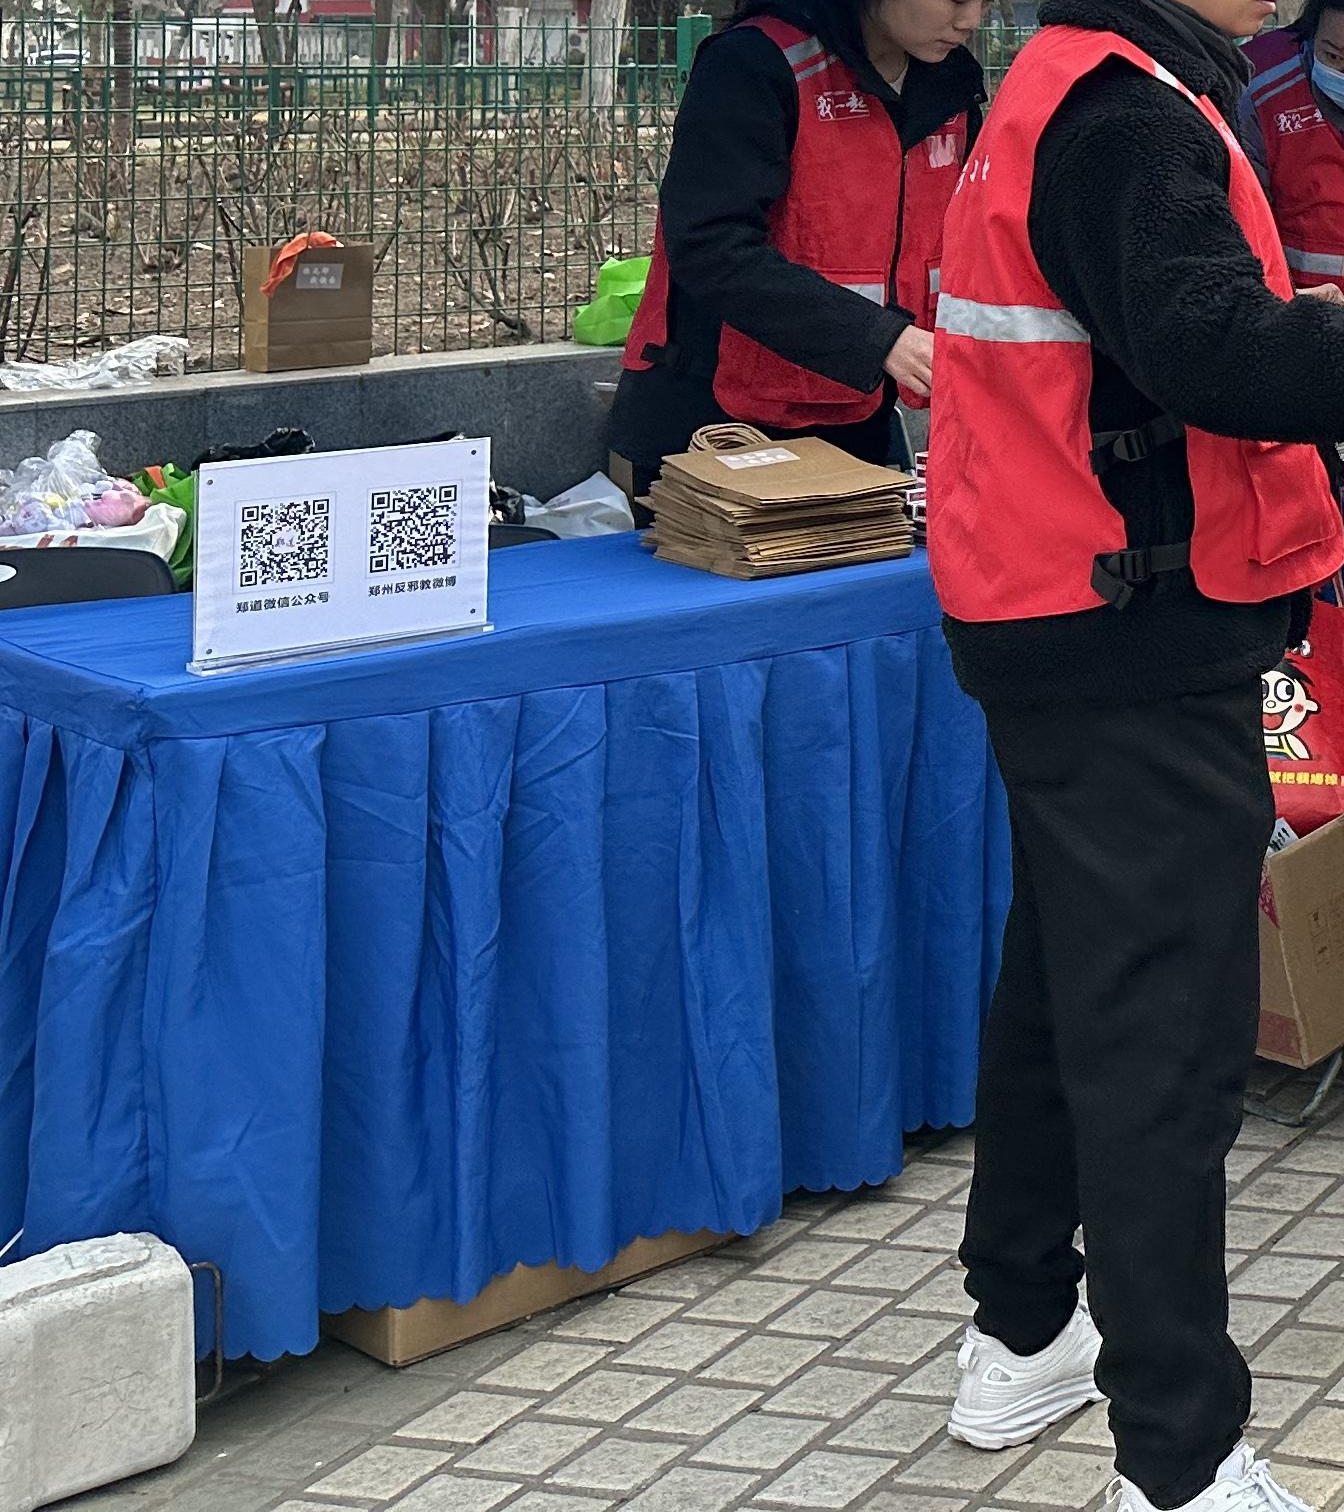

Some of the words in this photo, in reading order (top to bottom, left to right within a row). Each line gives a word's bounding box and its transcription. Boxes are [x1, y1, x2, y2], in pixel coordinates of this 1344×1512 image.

[368, 575, 457, 597] 郑州反邪教微博
[236, 592, 329, 614] 郑道微信公众号
